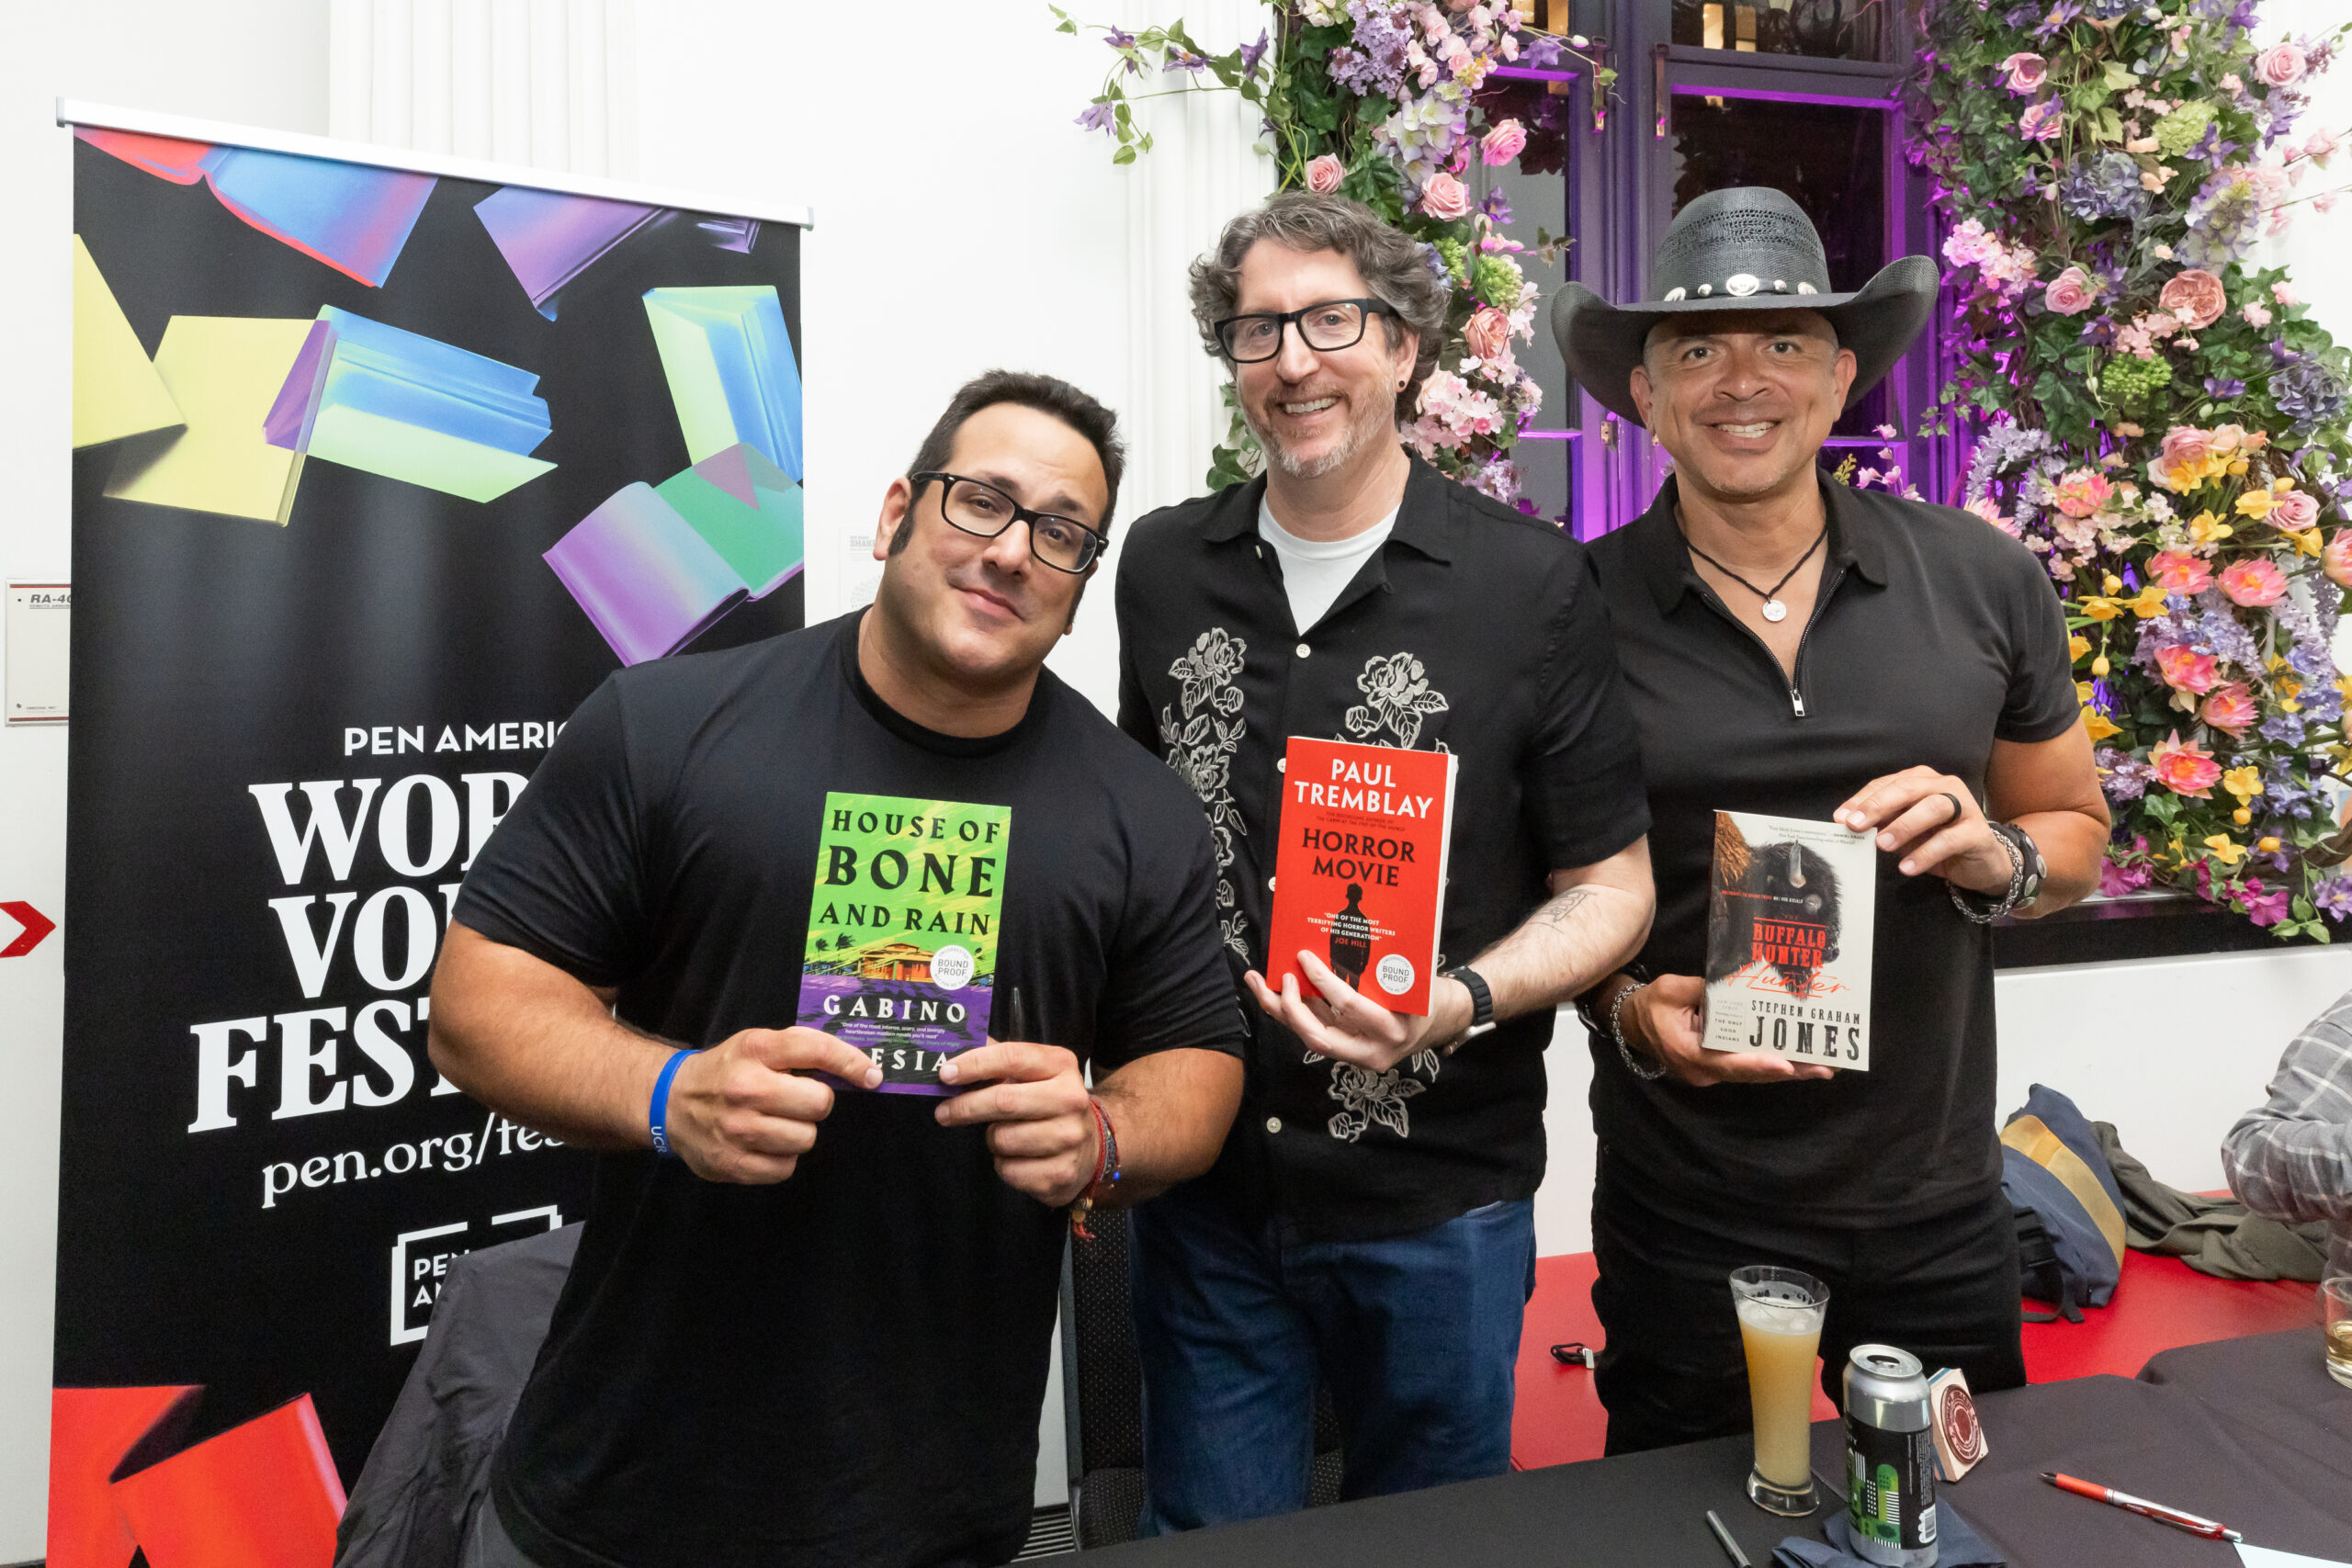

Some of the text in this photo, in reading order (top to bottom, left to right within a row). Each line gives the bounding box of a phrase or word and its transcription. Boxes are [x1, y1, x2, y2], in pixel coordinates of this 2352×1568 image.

[345, 725, 424, 756] PEN
[1331, 759, 1396, 787] PAUL
[1295, 781, 1433, 818] TREMBLAY
[831, 809, 1000, 843] HOUSE OF
[1303, 828, 1415, 863] HORROR
[823, 845, 996, 897] BONE
[1312, 855, 1399, 886] MOVIE
[818, 901, 990, 935] AND RAIN
[1306, 917, 1396, 936] TERRIFYING HORROR WRITERS
[1335, 937, 1367, 948] JOE HILL
[1753, 923, 1826, 949] BUFFALO
[938, 959, 968, 968] BOUND
[1752, 942, 1823, 968] HUNTER
[938, 967, 967, 976] PROOF
[1383, 965, 1409, 976] BOUND
[1383, 973, 1409, 983] PROOF
[1724, 963, 1851, 996] Hunter
[823, 995, 966, 1022] GABINO
[1752, 999, 1860, 1025] STEPHEN GRAHAM
[1749, 1015, 1860, 1060] JONES
[414, 1248, 469, 1280] PE
